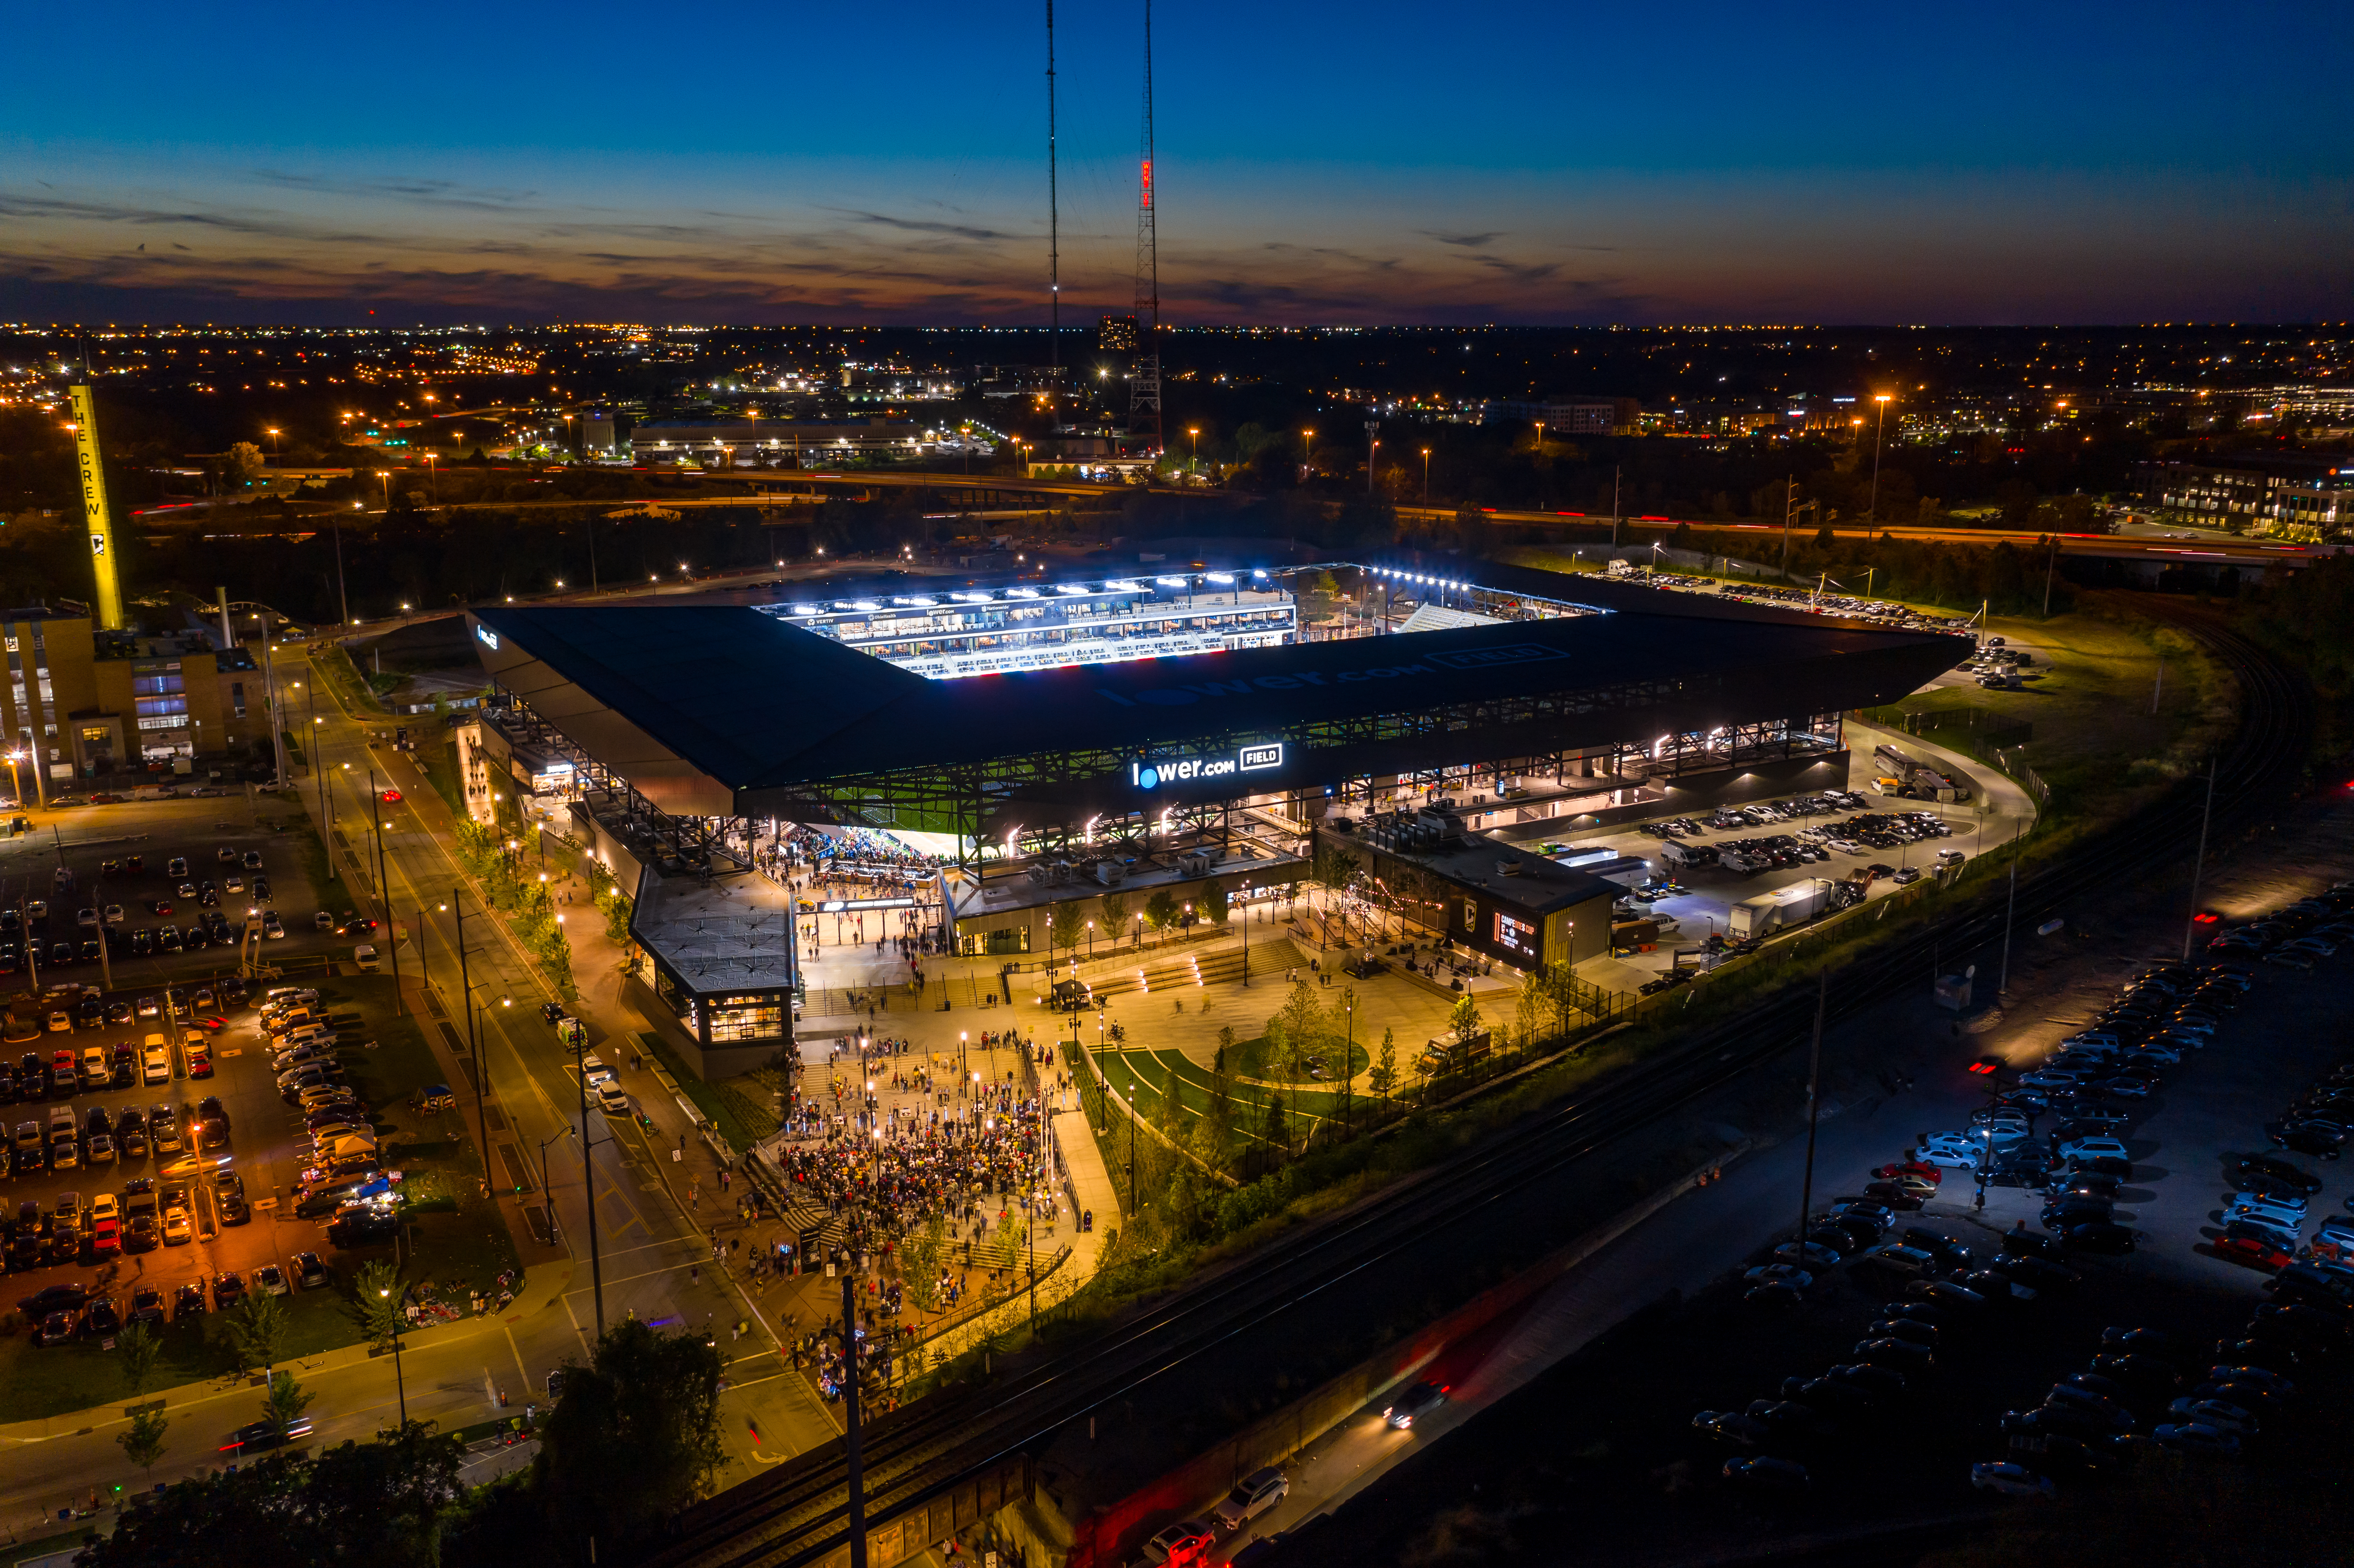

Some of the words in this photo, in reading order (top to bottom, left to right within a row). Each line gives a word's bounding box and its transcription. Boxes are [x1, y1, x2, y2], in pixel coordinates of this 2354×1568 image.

[72, 395, 86, 441] THE
[80, 453, 99, 515] CREW
[1451, 649, 1542, 663] FIELD
[1246, 750, 1276, 764] FIELD
[1501, 915, 1525, 932] CAMPEONES
[1525, 925, 1534, 935] CUP
